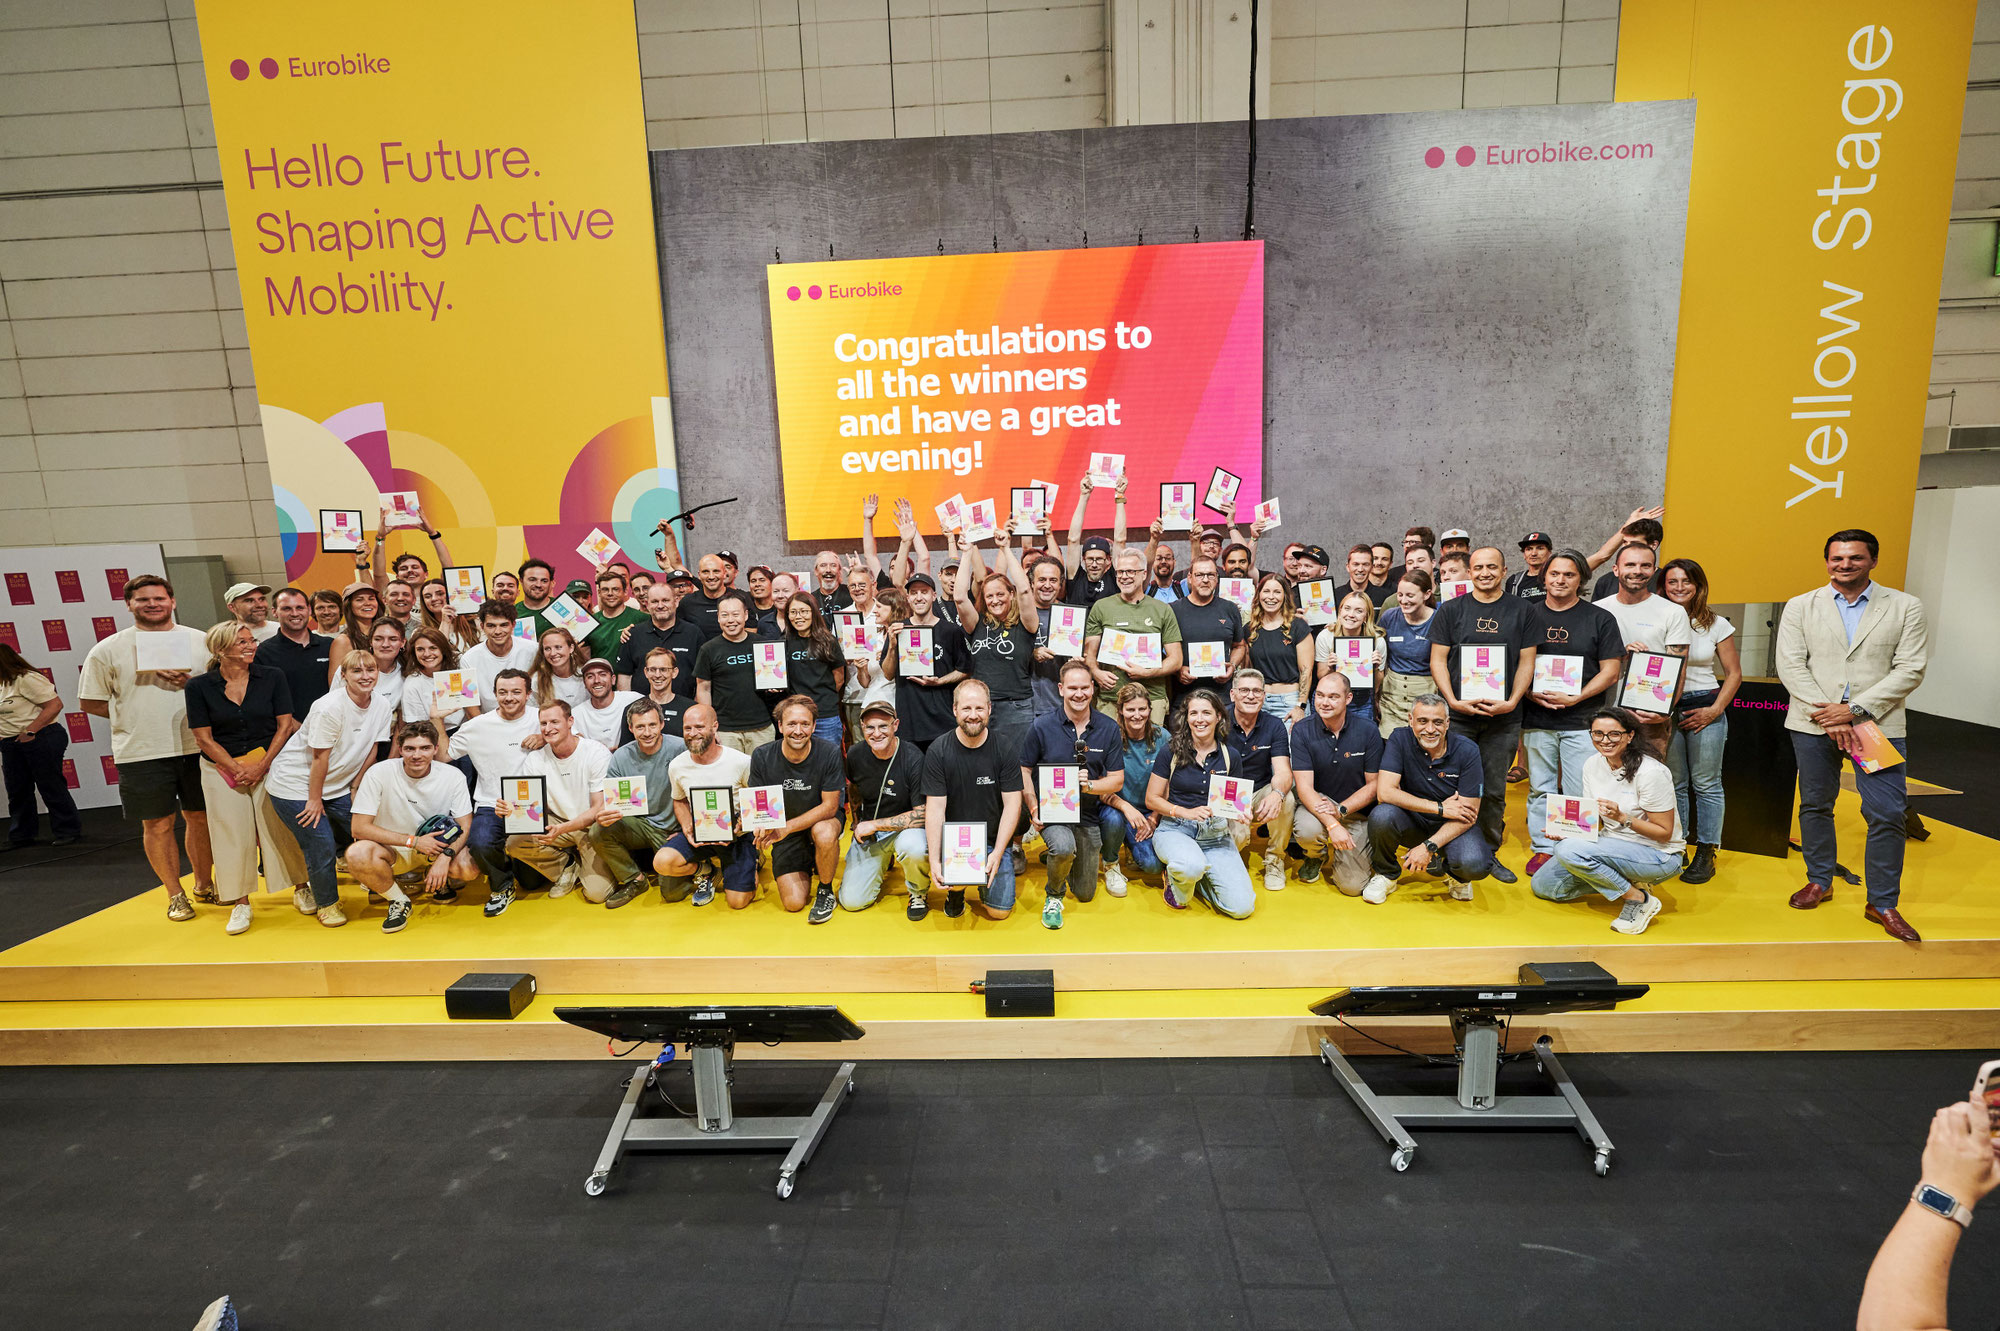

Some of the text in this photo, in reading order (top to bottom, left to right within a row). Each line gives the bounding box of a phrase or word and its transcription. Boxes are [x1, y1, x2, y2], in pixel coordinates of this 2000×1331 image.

[288, 53, 391, 78] Eurobike
[244, 139, 541, 190] Hello Future.
[1486, 140, 1654, 166] Eurobike.com
[255, 200, 615, 262] Shaping Active
[1785, 24, 1904, 509] Yellow Stage
[264, 270, 454, 321] Mobility.
[828, 281, 903, 300] Eurobike
[833, 321, 1153, 367] Congratulations to
[836, 363, 1088, 401] all the winners
[839, 397, 1121, 438] and have a great
[841, 440, 983, 477] evening!
[1733, 698, 1790, 711] Eurobike
